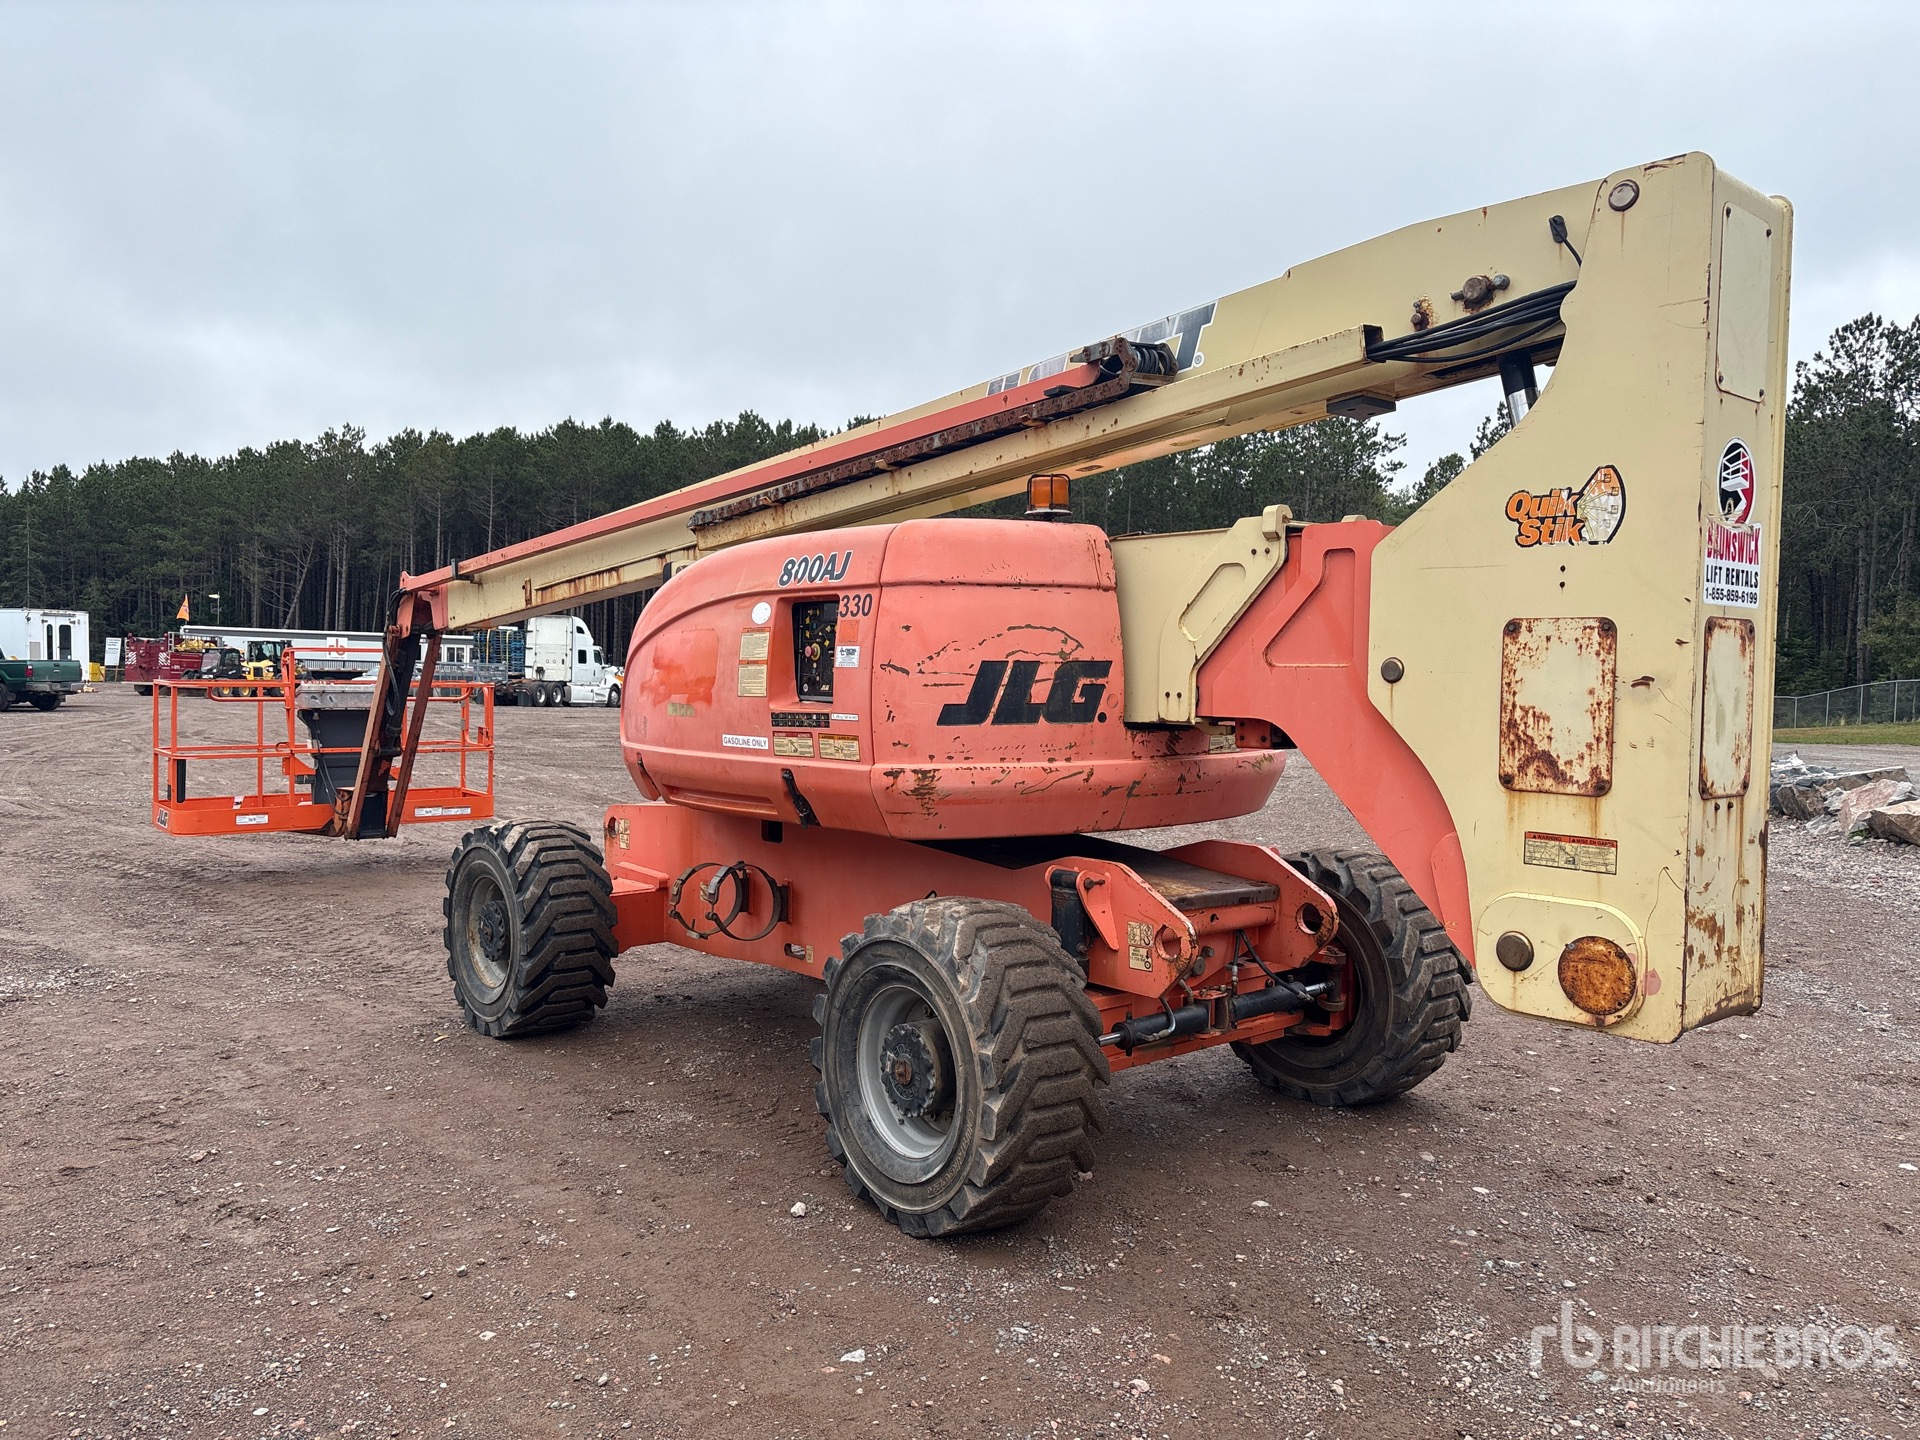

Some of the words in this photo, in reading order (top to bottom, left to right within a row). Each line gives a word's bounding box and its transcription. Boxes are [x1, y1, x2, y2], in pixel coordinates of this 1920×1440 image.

[1507, 489, 1580, 522] Quik
[1517, 517, 1584, 546] Stik
[778, 550, 853, 587] 800AJ
[1706, 564, 1722, 584] LIFT
[1725, 567, 1759, 589] RENTALS
[839, 593, 873, 618] 330
[1705, 586, 1758, 605] 1-855-859-6199
[723, 736, 751, 747] GASOLINE
[751, 738, 767, 748] ONLY
